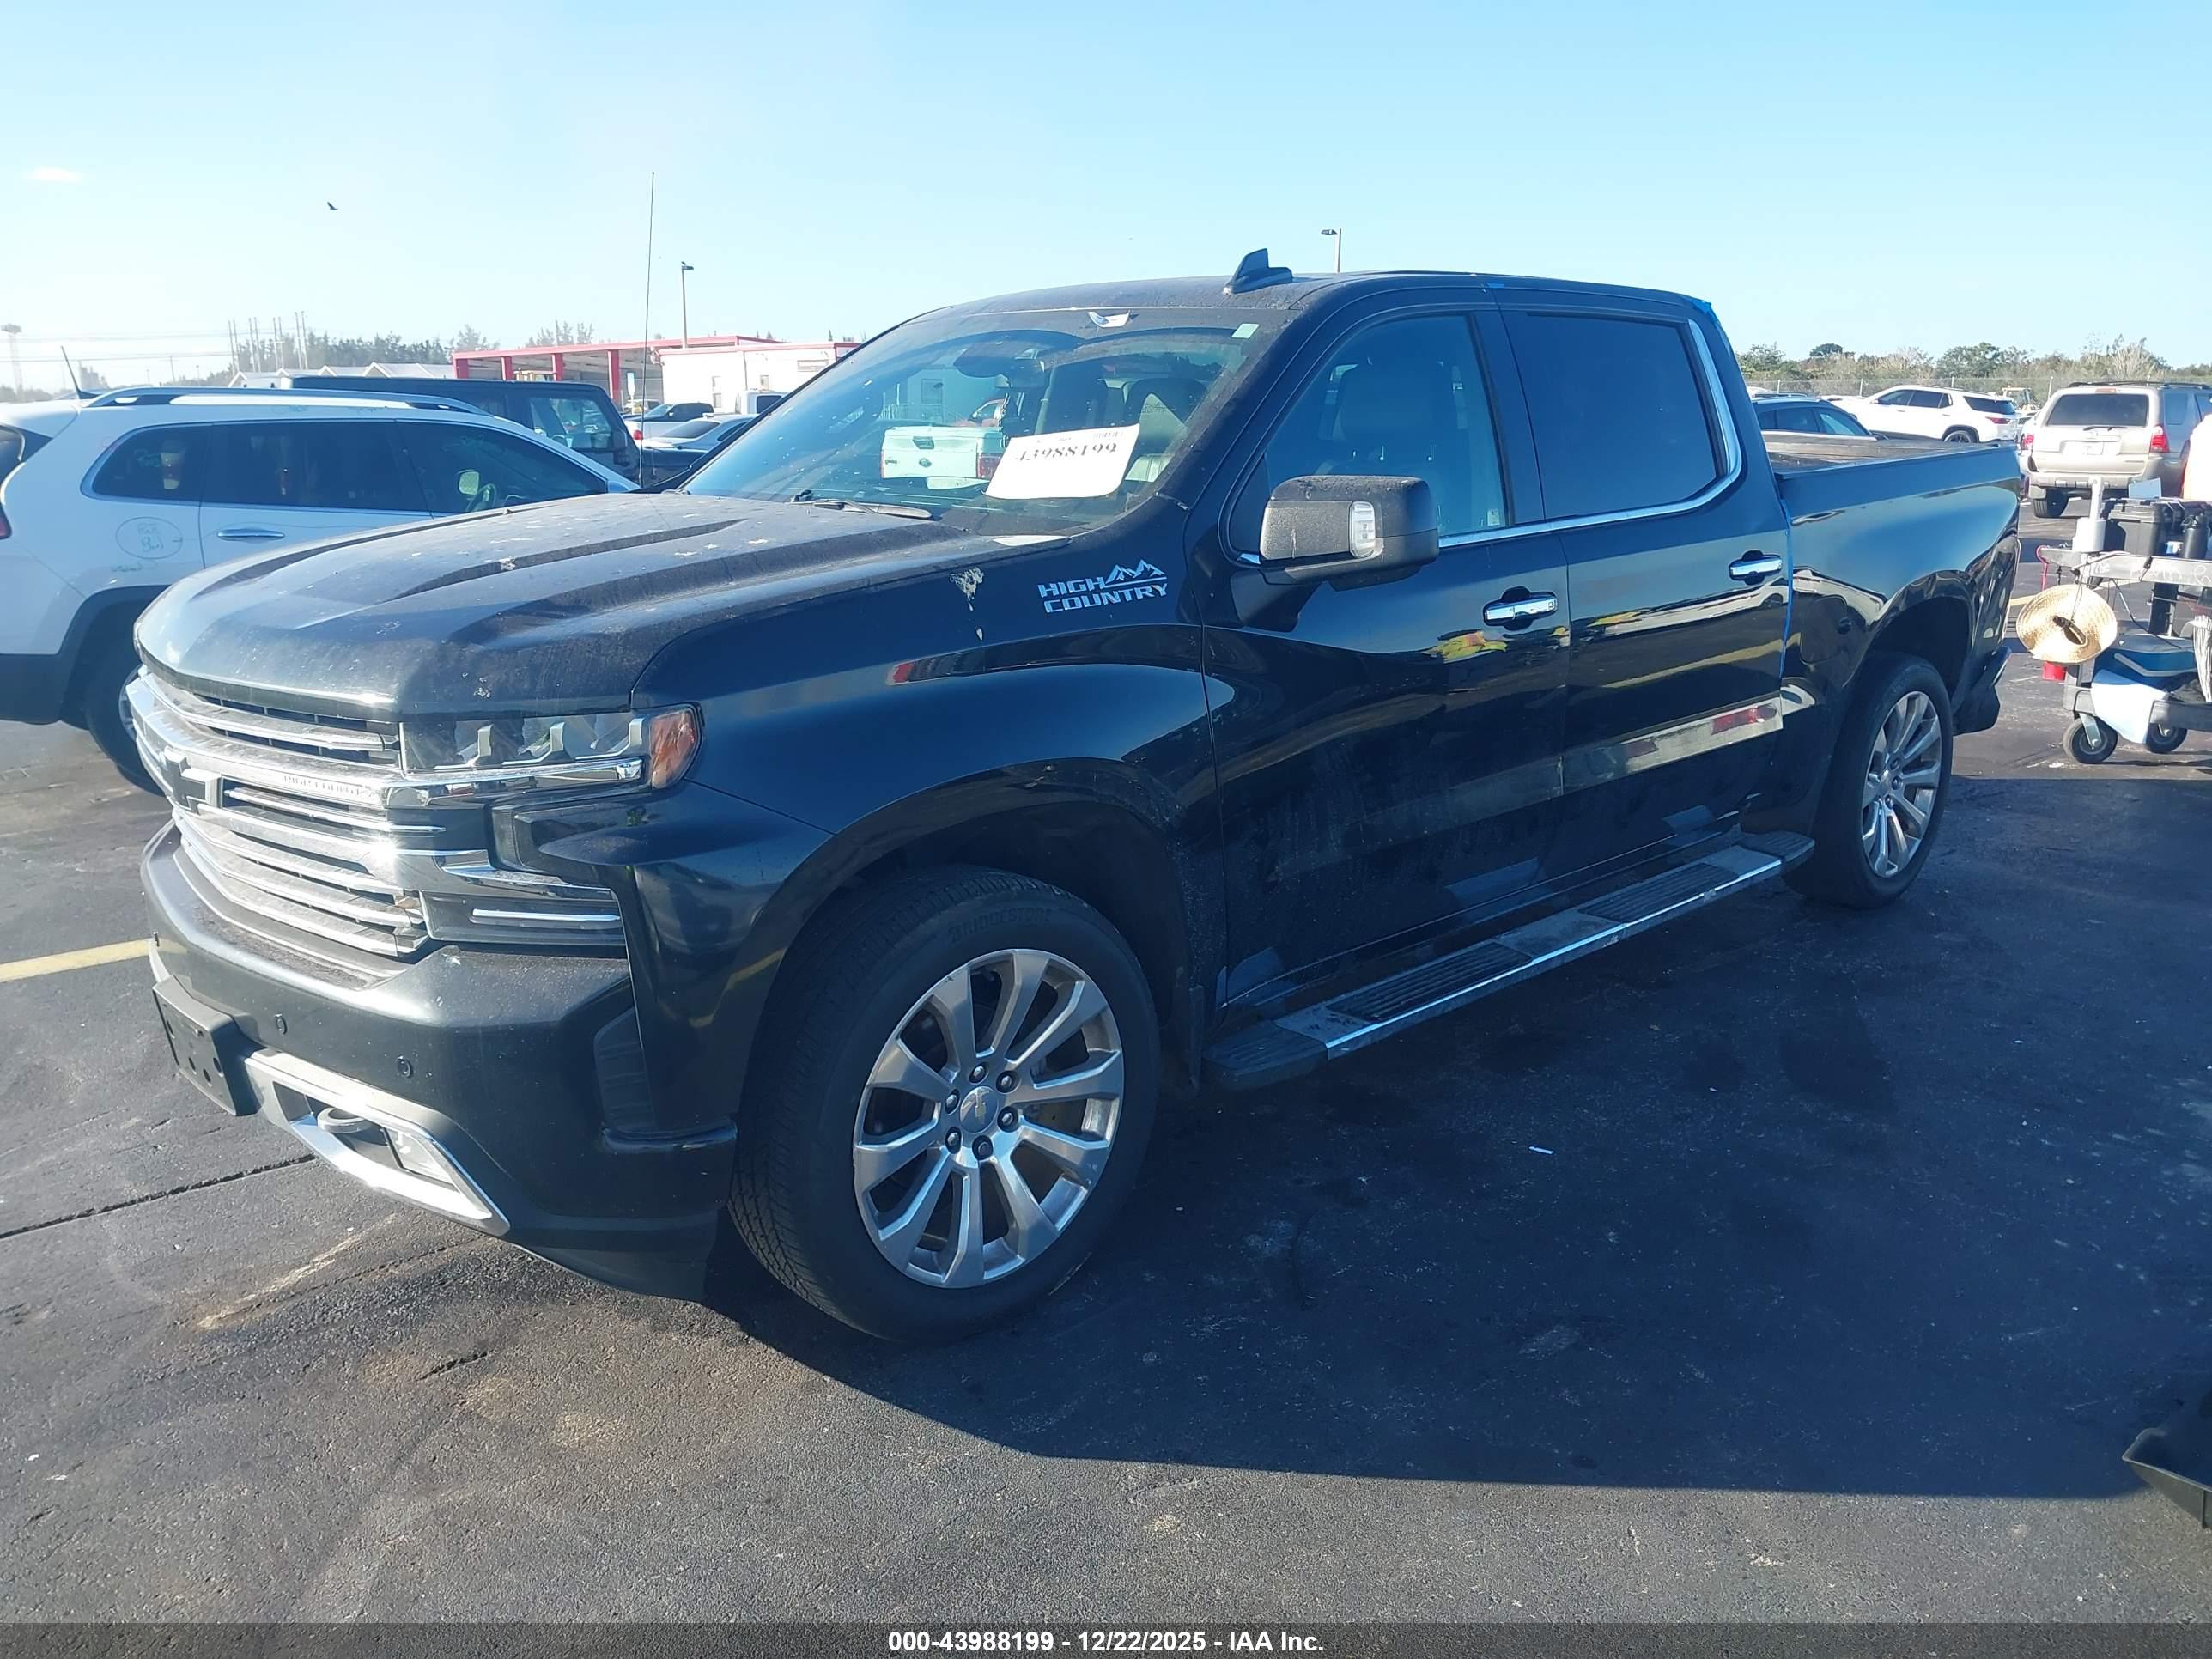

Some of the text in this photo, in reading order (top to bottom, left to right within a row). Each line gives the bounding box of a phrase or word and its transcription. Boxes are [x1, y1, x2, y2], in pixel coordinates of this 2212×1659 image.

[1014, 442, 1118, 462] 43988199
[1037, 576, 1107, 599] HIGH
[1043, 583, 1168, 613] COUNTRY
